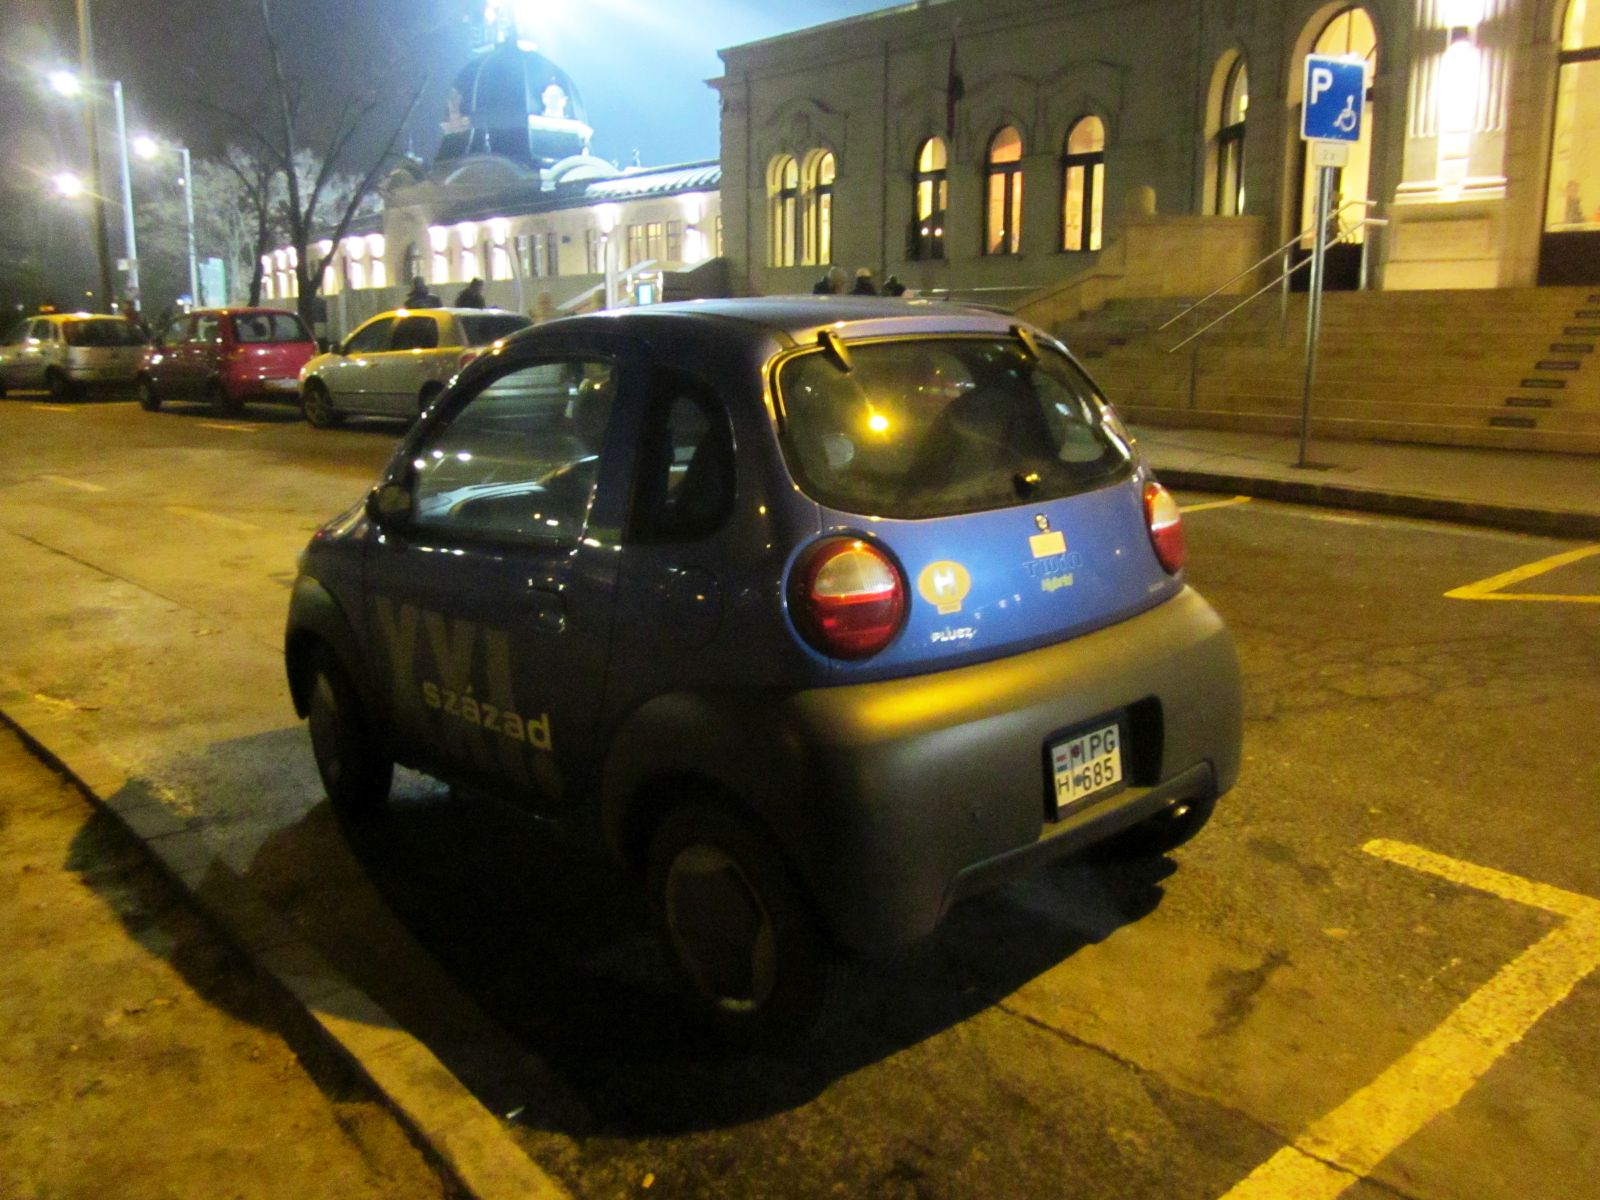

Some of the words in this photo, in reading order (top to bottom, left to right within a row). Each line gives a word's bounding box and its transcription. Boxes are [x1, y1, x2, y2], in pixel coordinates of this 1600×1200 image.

[1310, 67, 1333, 105] P
[933, 567, 957, 597] H
[421, 680, 553, 751] század
[1080, 729, 1116, 764] IPG
[1057, 775, 1070, 795] H
[1082, 757, 1114, 791] 685
